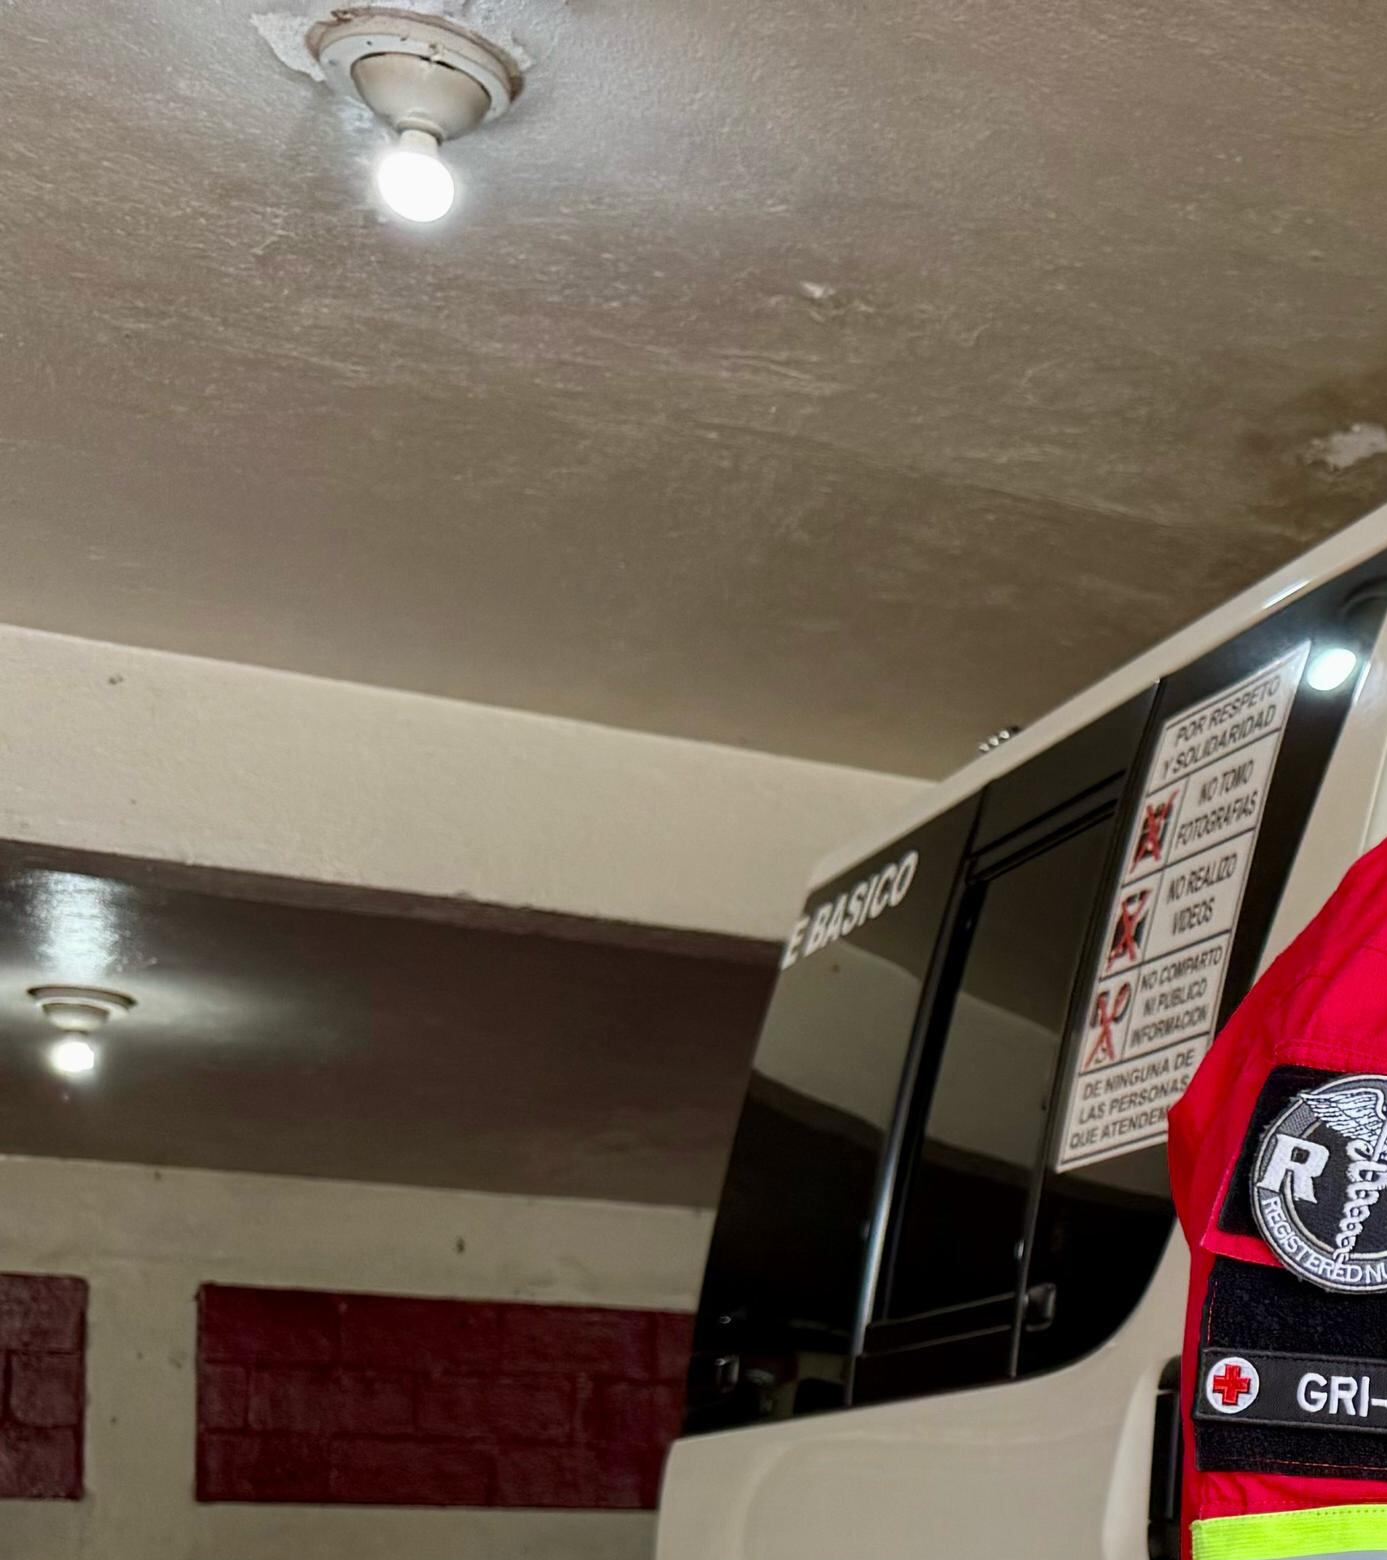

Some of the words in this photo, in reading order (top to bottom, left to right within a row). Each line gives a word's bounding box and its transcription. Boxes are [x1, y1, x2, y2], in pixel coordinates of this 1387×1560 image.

[1175, 717, 1207, 745] POR
[1208, 675, 1281, 728] RESPETO
[1163, 758, 1174, 780] Y
[1173, 704, 1277, 773] SOLIDARIDAD
[1199, 776, 1219, 805] NO
[1220, 760, 1254, 796] TOMO
[1175, 790, 1259, 846] FOTOGRAFIAS
[803, 849, 919, 958] BASICO
[1167, 874, 1186, 904] NO
[1186, 852, 1238, 896] REALIZO
[1172, 897, 1215, 937] VIDEOS
[1140, 971, 1158, 992] NO
[1158, 946, 1223, 985] COMPARTO
[1156, 979, 1207, 1014] PUBLICO
[1130, 1004, 1209, 1048] INFORMACION
[1079, 1103, 1106, 1125] LAS
[1109, 1074, 1190, 1116] PERSONAS
[1083, 1081, 1102, 1101] DE
[1104, 1059, 1169, 1093] NINGUNA
[1174, 1049, 1195, 1068] DE
[1069, 1128, 1099, 1150] QUE
[1256, 1134, 1330, 1204] R
[1262, 1197, 1363, 1283] REGISTERED
